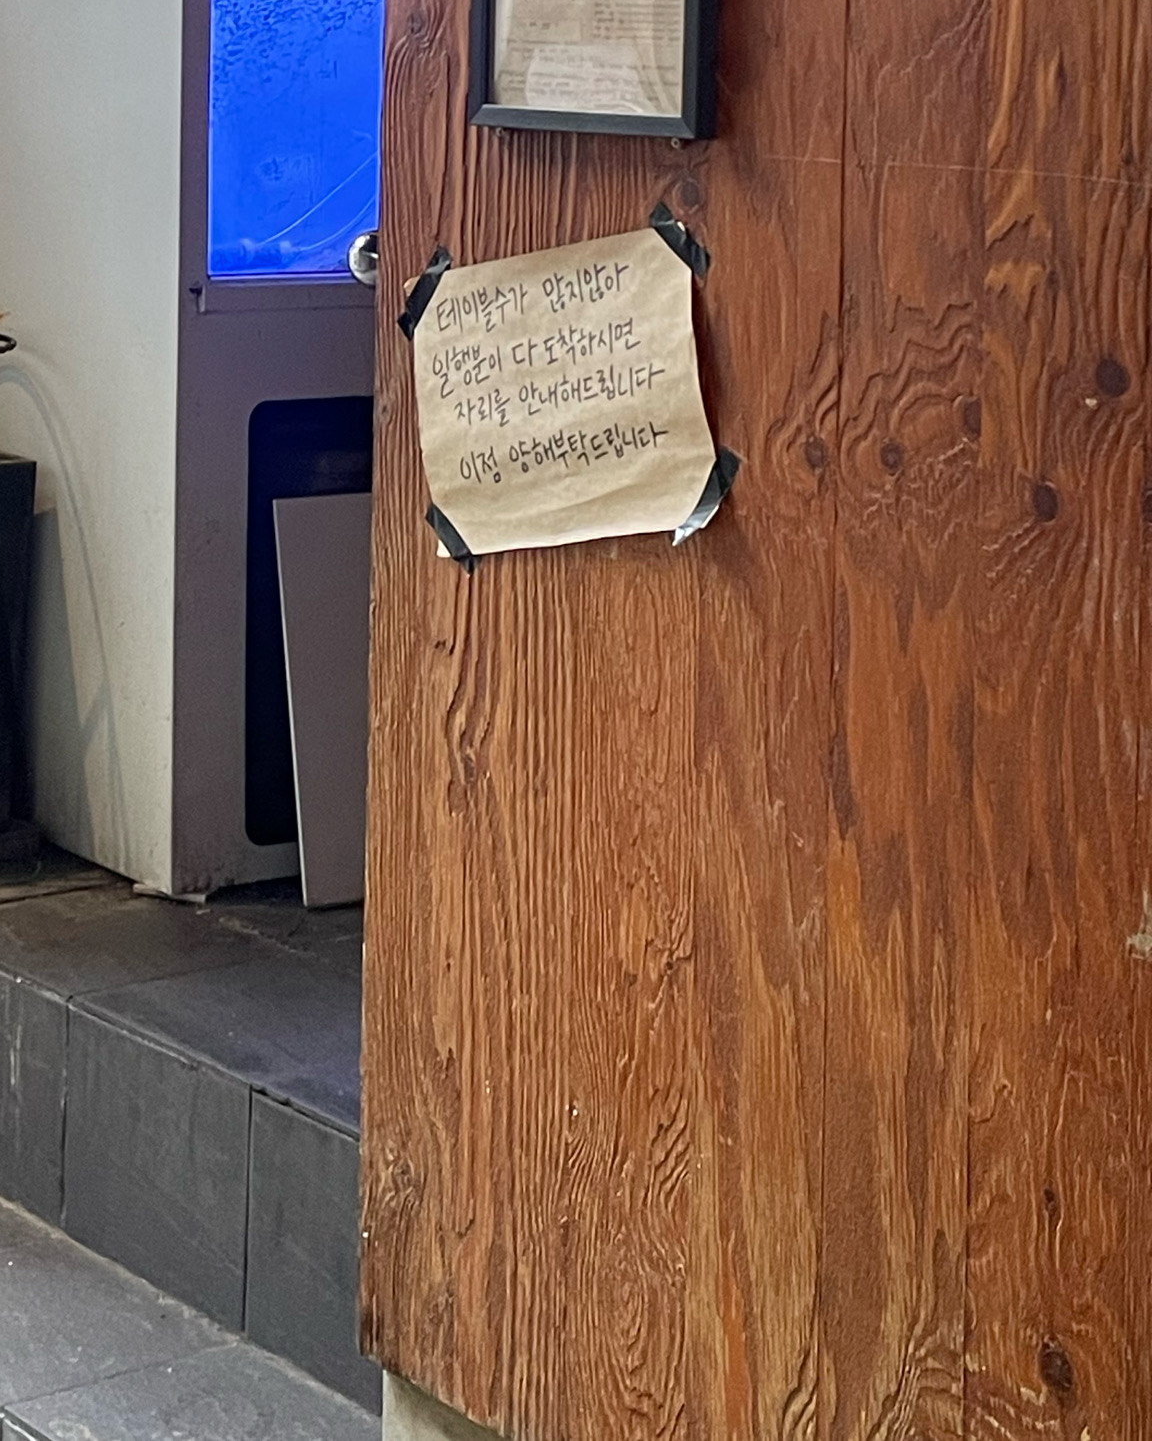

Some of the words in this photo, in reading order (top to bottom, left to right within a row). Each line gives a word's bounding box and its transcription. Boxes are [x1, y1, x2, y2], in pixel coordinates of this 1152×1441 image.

[436, 282, 528, 333] 테이블수가
[542, 262, 630, 314] 많지않아
[432, 343, 503, 399] 일행분이
[543, 317, 641, 365] 도착하시면
[454, 388, 511, 427] 자리를
[518, 362, 666, 416] 안내해드립니다
[508, 421, 670, 472] 양해부탁드립니다
